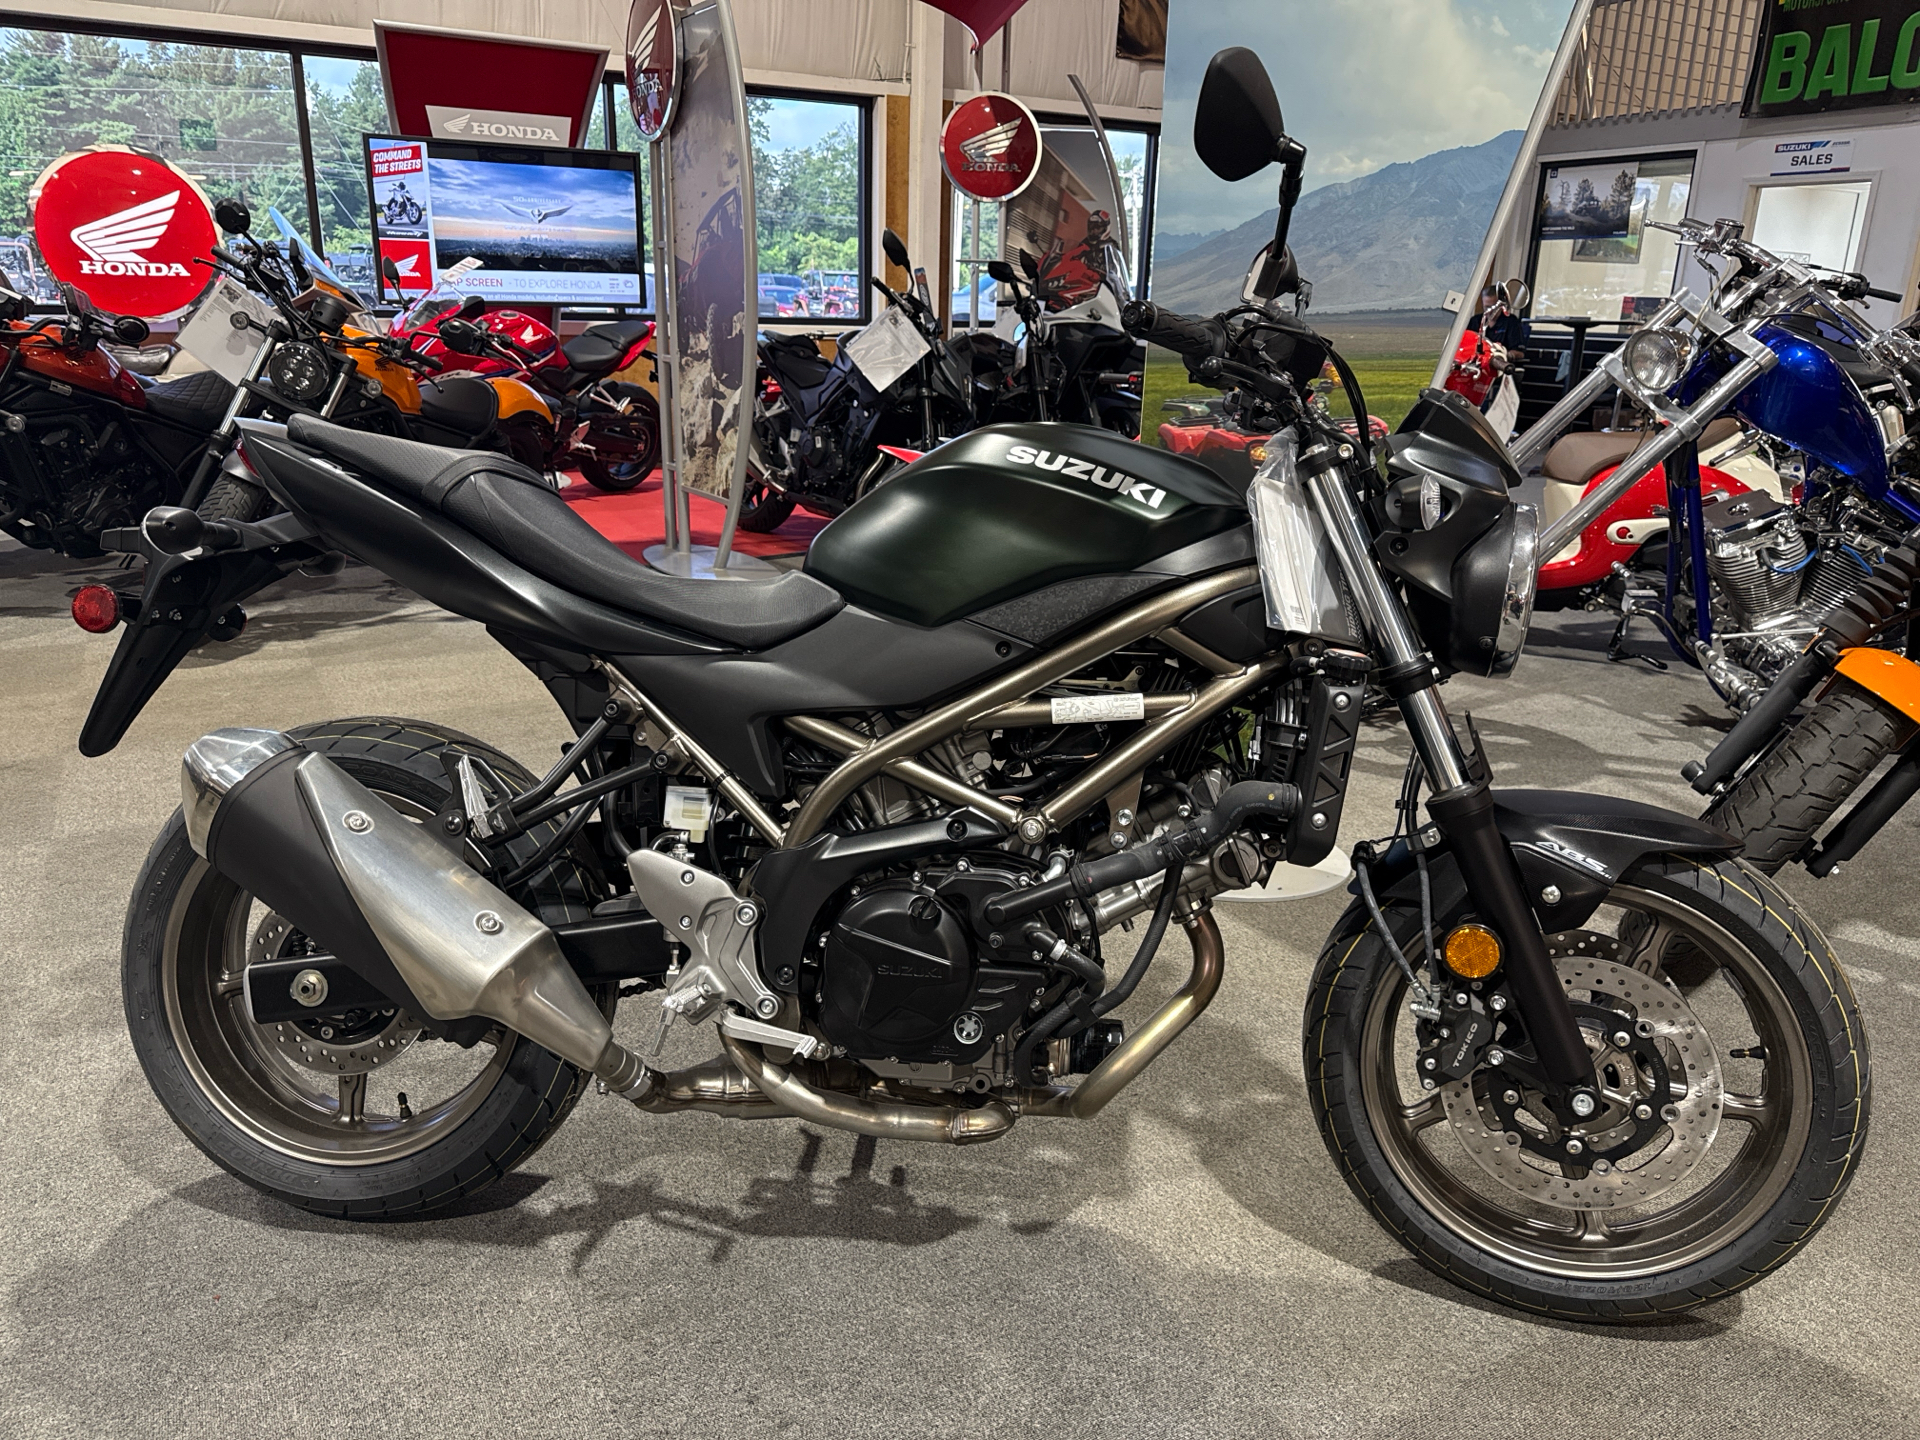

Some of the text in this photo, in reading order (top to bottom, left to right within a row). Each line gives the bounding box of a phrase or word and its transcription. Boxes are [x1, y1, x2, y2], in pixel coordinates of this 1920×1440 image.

[470, 121, 560, 142] HONDA
[1777, 143, 1811, 152] SUZUKI
[372, 148, 412, 163] COMMAND
[1790, 153, 1833, 167] SALES
[374, 159, 422, 174] THE STREETS
[961, 162, 1022, 173] HONDA
[78, 260, 191, 277] HONDA
[465, 277, 503, 288] SCREEN
[513, 278, 527, 288] TO
[528, 279, 569, 289] EXPLORE
[570, 280, 602, 290] HONDA
[1006, 445, 1167, 510] SUZUKI
[1535, 841, 1610, 875] ABS
[877, 964, 943, 979] SUZUKI
[1451, 1021, 1479, 1068] TOKICO
